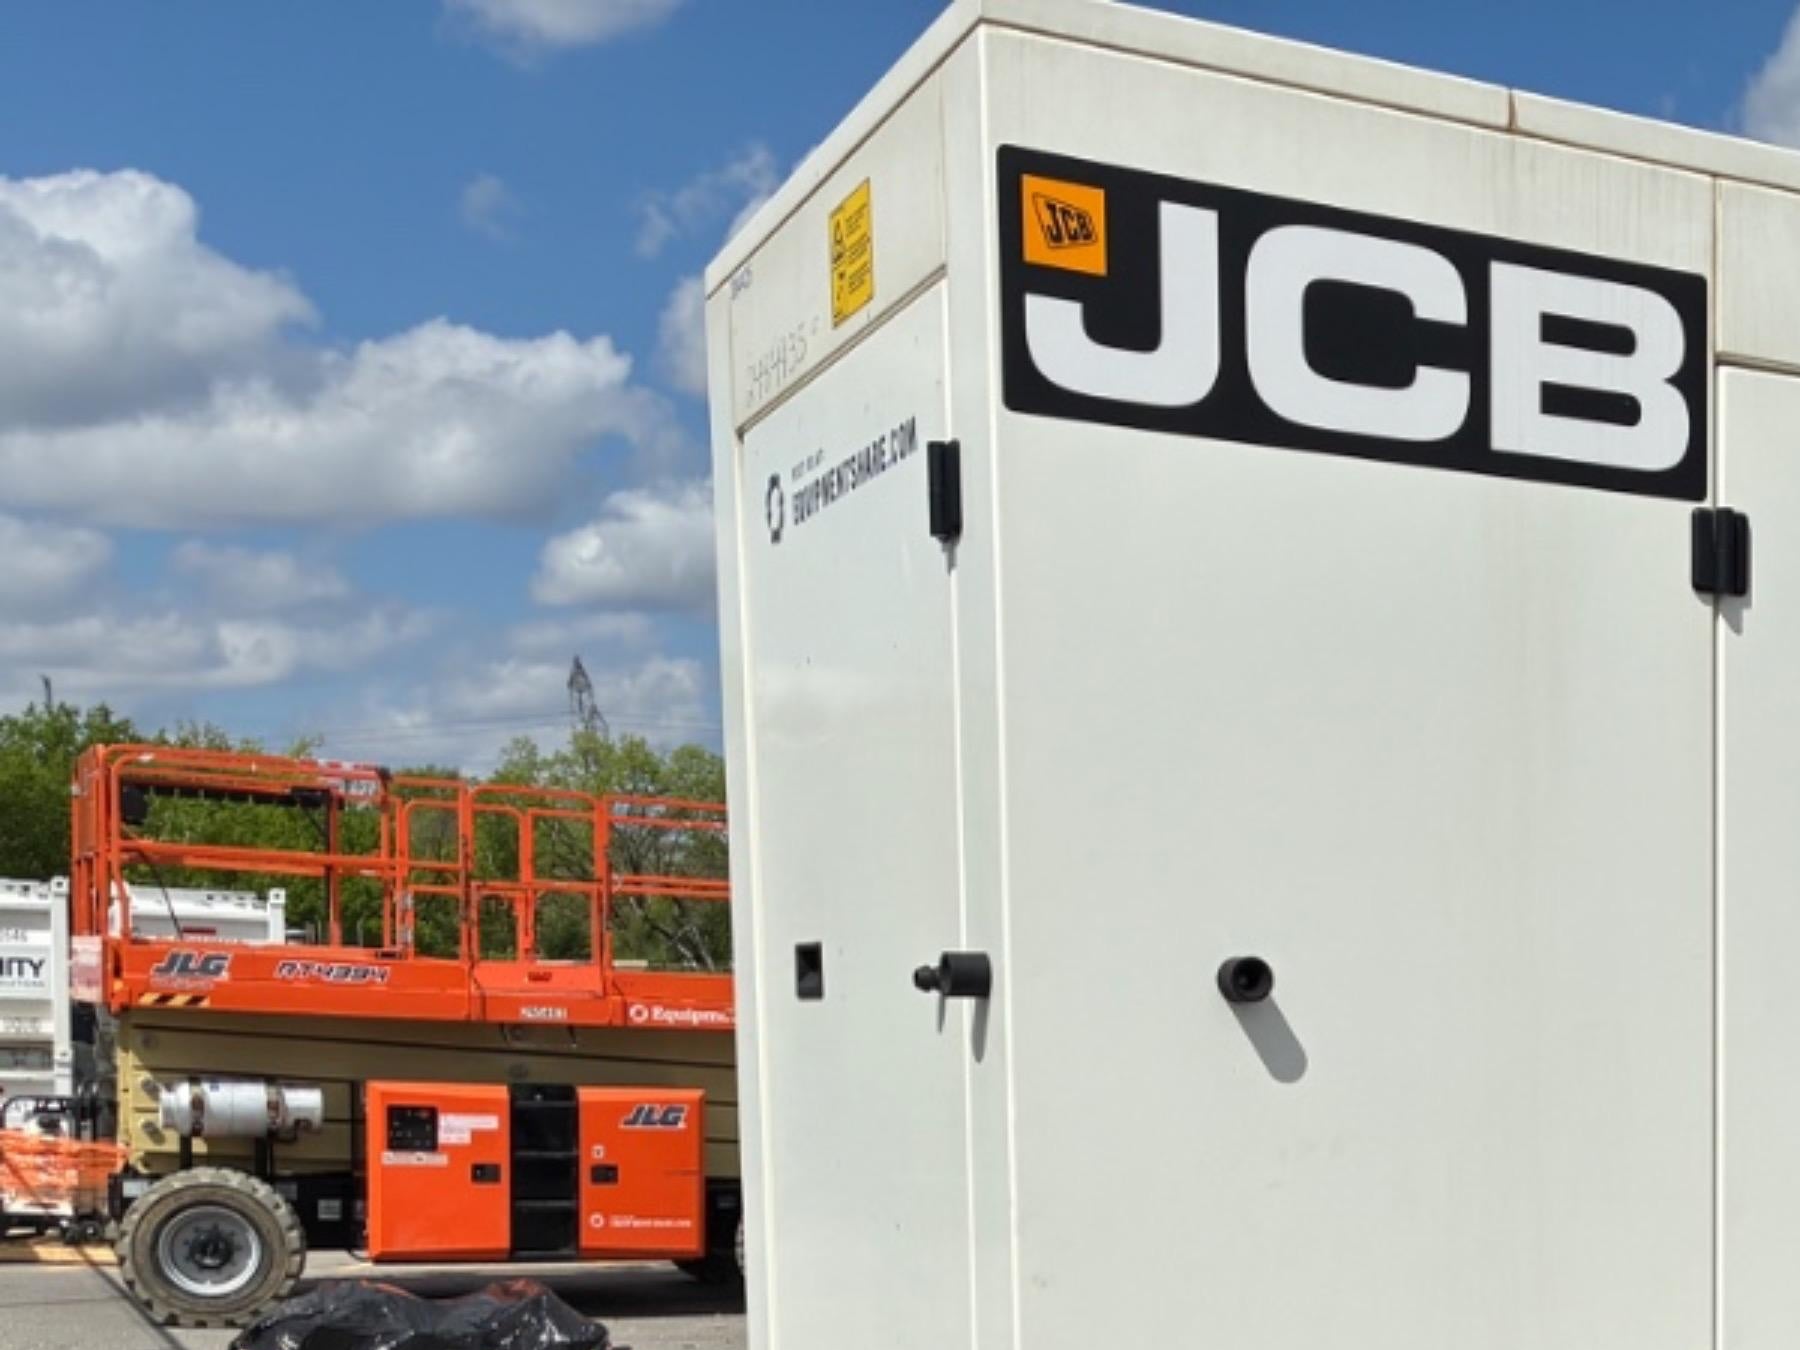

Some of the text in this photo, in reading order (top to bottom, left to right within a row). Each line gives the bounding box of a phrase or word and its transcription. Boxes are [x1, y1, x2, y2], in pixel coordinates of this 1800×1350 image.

[1043, 201, 1094, 243] JCB
[1024, 200, 1690, 472] JCB
[0, 957, 46, 978] ITY
[152, 950, 230, 979] JLG
[620, 1103, 688, 1129] JLG
